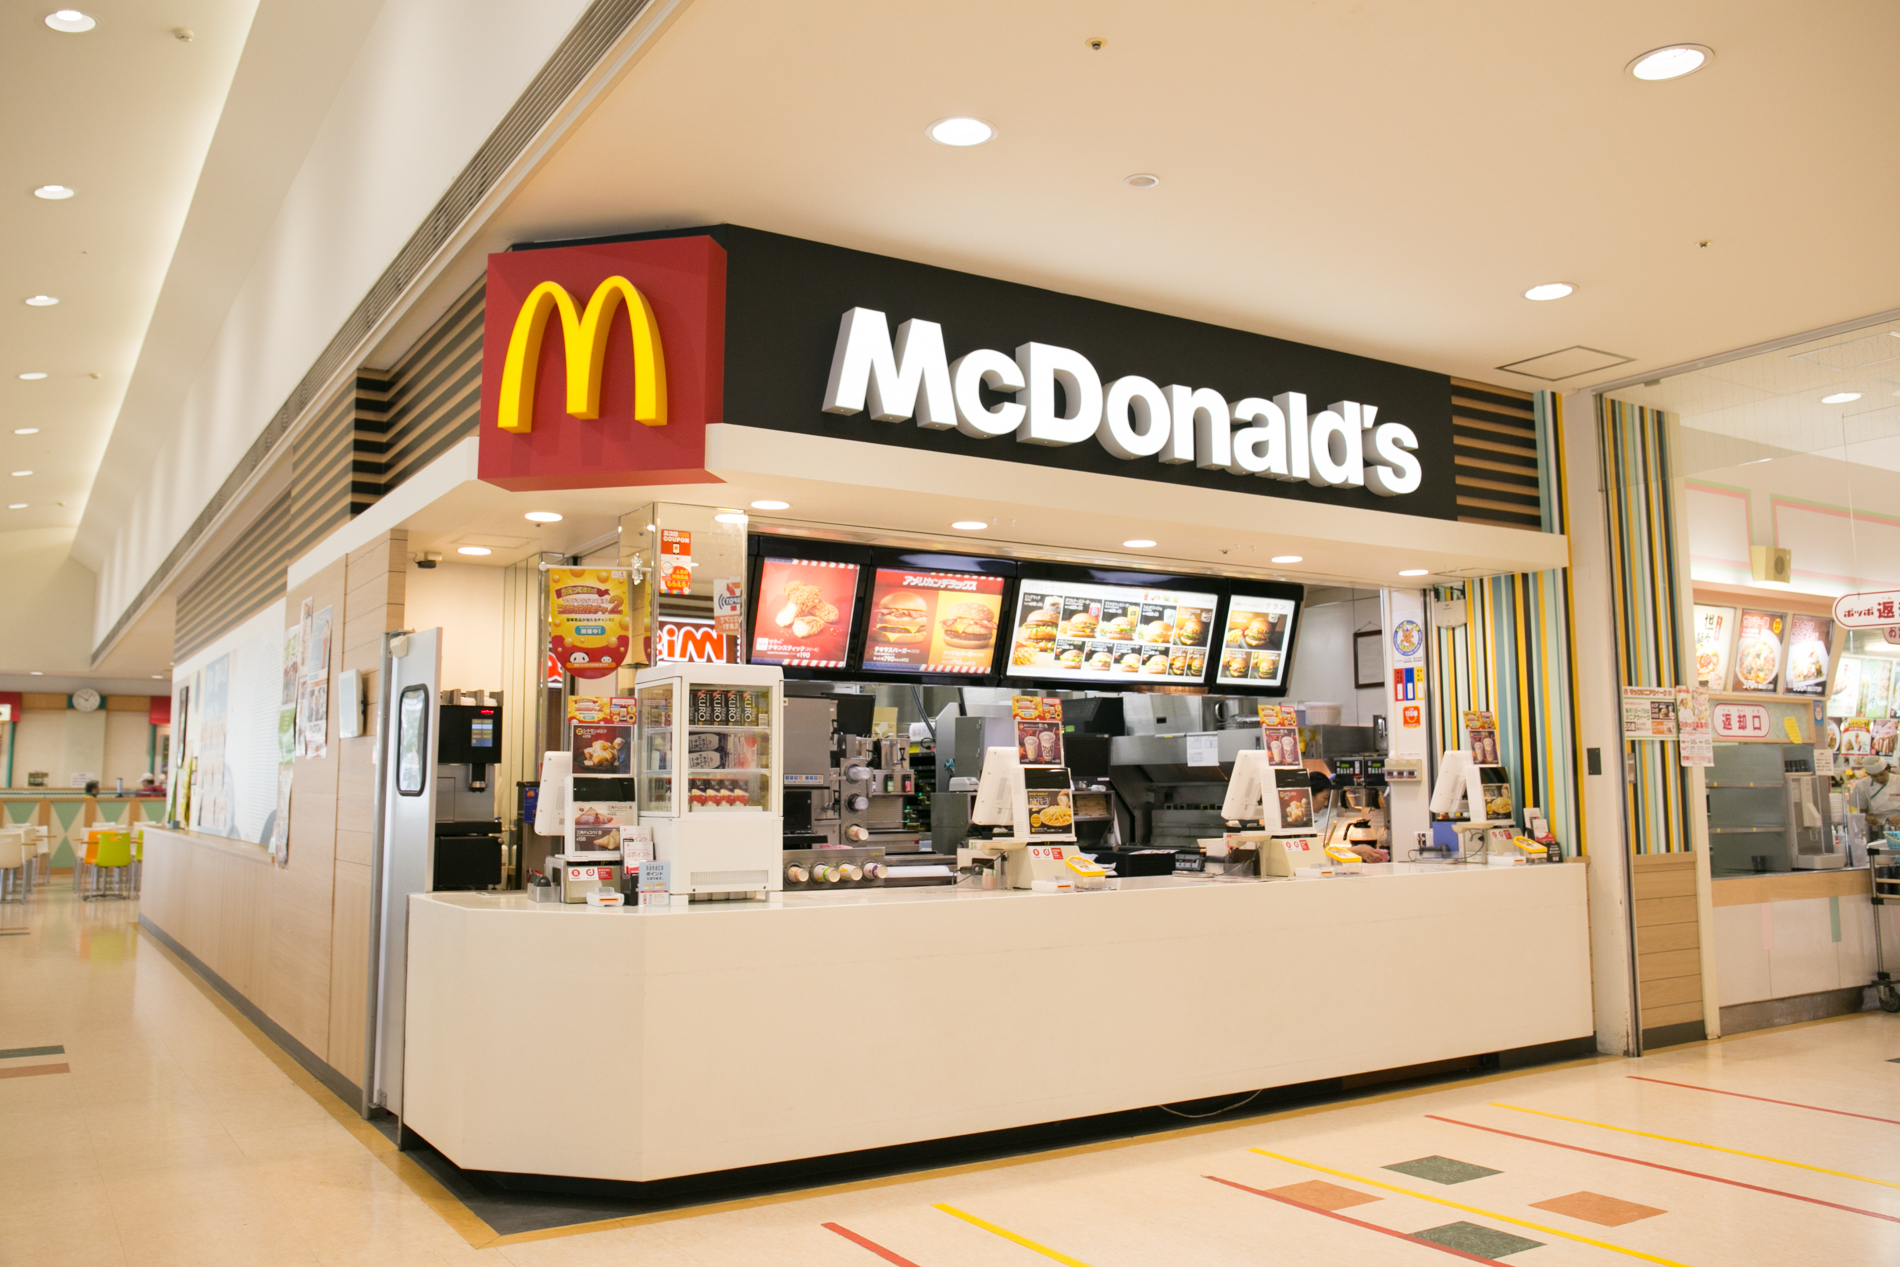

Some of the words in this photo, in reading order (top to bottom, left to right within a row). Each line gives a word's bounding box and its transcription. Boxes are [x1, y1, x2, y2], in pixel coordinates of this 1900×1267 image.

[822, 307, 1422, 497] McDonald's
[902, 575, 978, 591] アメリカンデラックス
[1877, 600, 1900, 619] 返
[1888, 627, 1900, 639] お
[1722, 713, 1762, 731] 返却口
